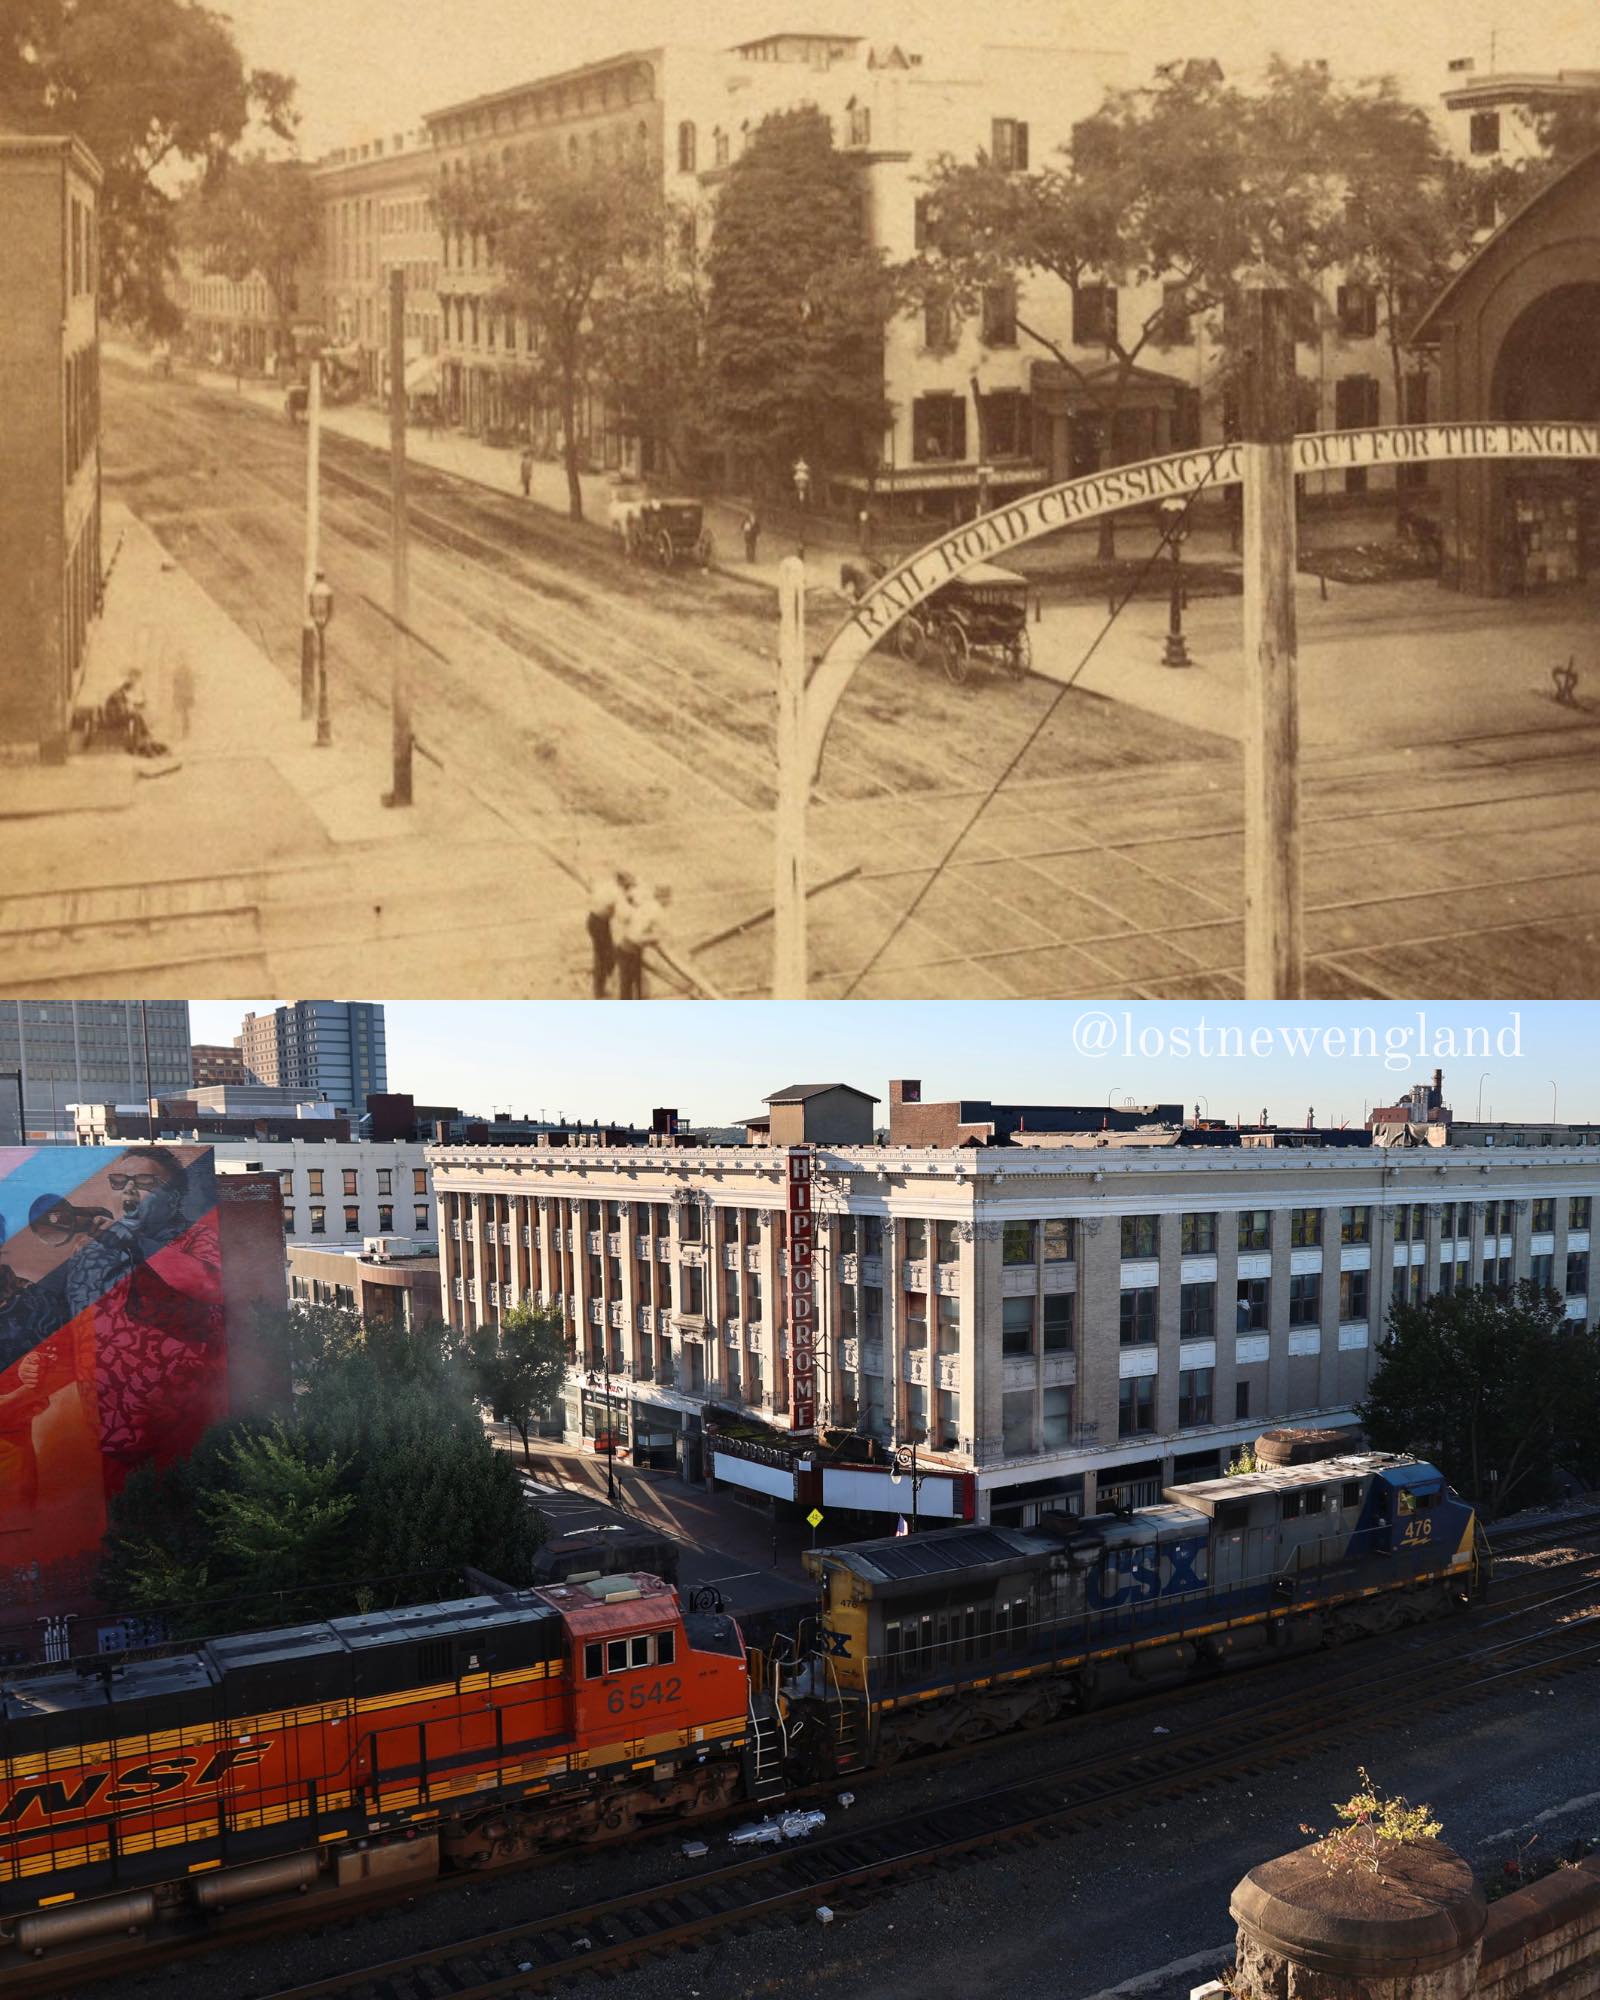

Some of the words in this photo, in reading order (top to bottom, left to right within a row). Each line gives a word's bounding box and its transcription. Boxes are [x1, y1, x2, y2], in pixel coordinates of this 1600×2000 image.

[855, 566, 935, 638] RAIL
[938, 507, 1029, 572] ROAD
[1037, 455, 1200, 524] CROSSING
[1300, 432, 1360, 467] OUT
[1371, 428, 1430, 460] FOR
[1438, 426, 1500, 456] THE
[792, 1158, 812, 1427] HIPPODROME
[1404, 1518, 1432, 1538] 476
[1087, 1534, 1210, 1612] CSX
[839, 1599, 859, 1609] 476
[607, 1676, 682, 1714] 6542
